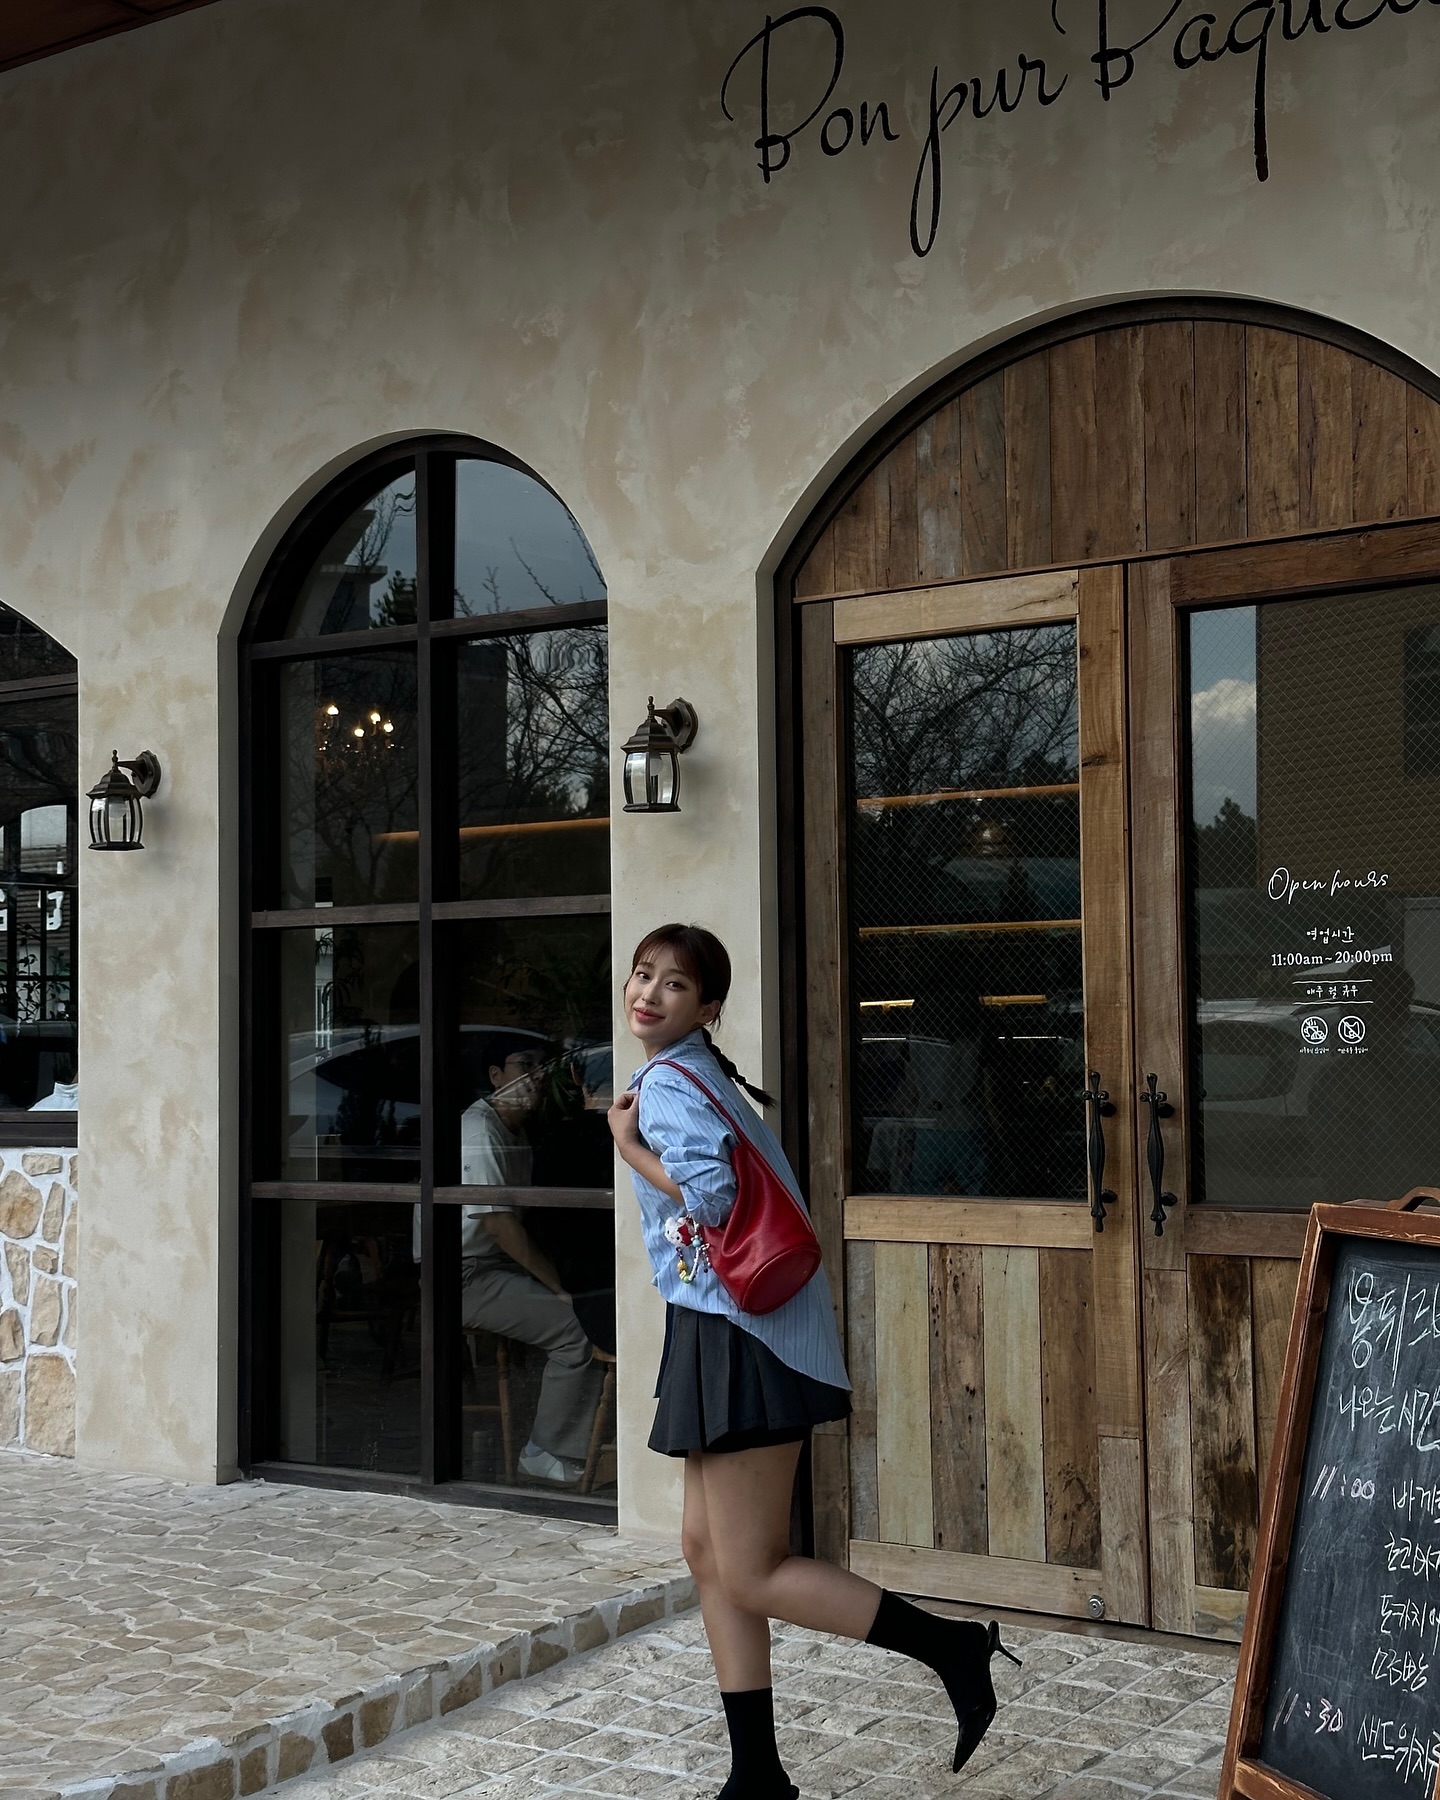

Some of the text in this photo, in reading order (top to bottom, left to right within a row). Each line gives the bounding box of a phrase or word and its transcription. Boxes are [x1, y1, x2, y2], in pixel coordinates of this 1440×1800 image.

[721, 6, 899, 184] Bon
[1268, 866, 1389, 904] Open hours
[1306, 925, 1355, 944] 영업시간
[1308, 1463, 1375, 1503] 11:00
[1272, 1687, 1344, 1735] 11:30
